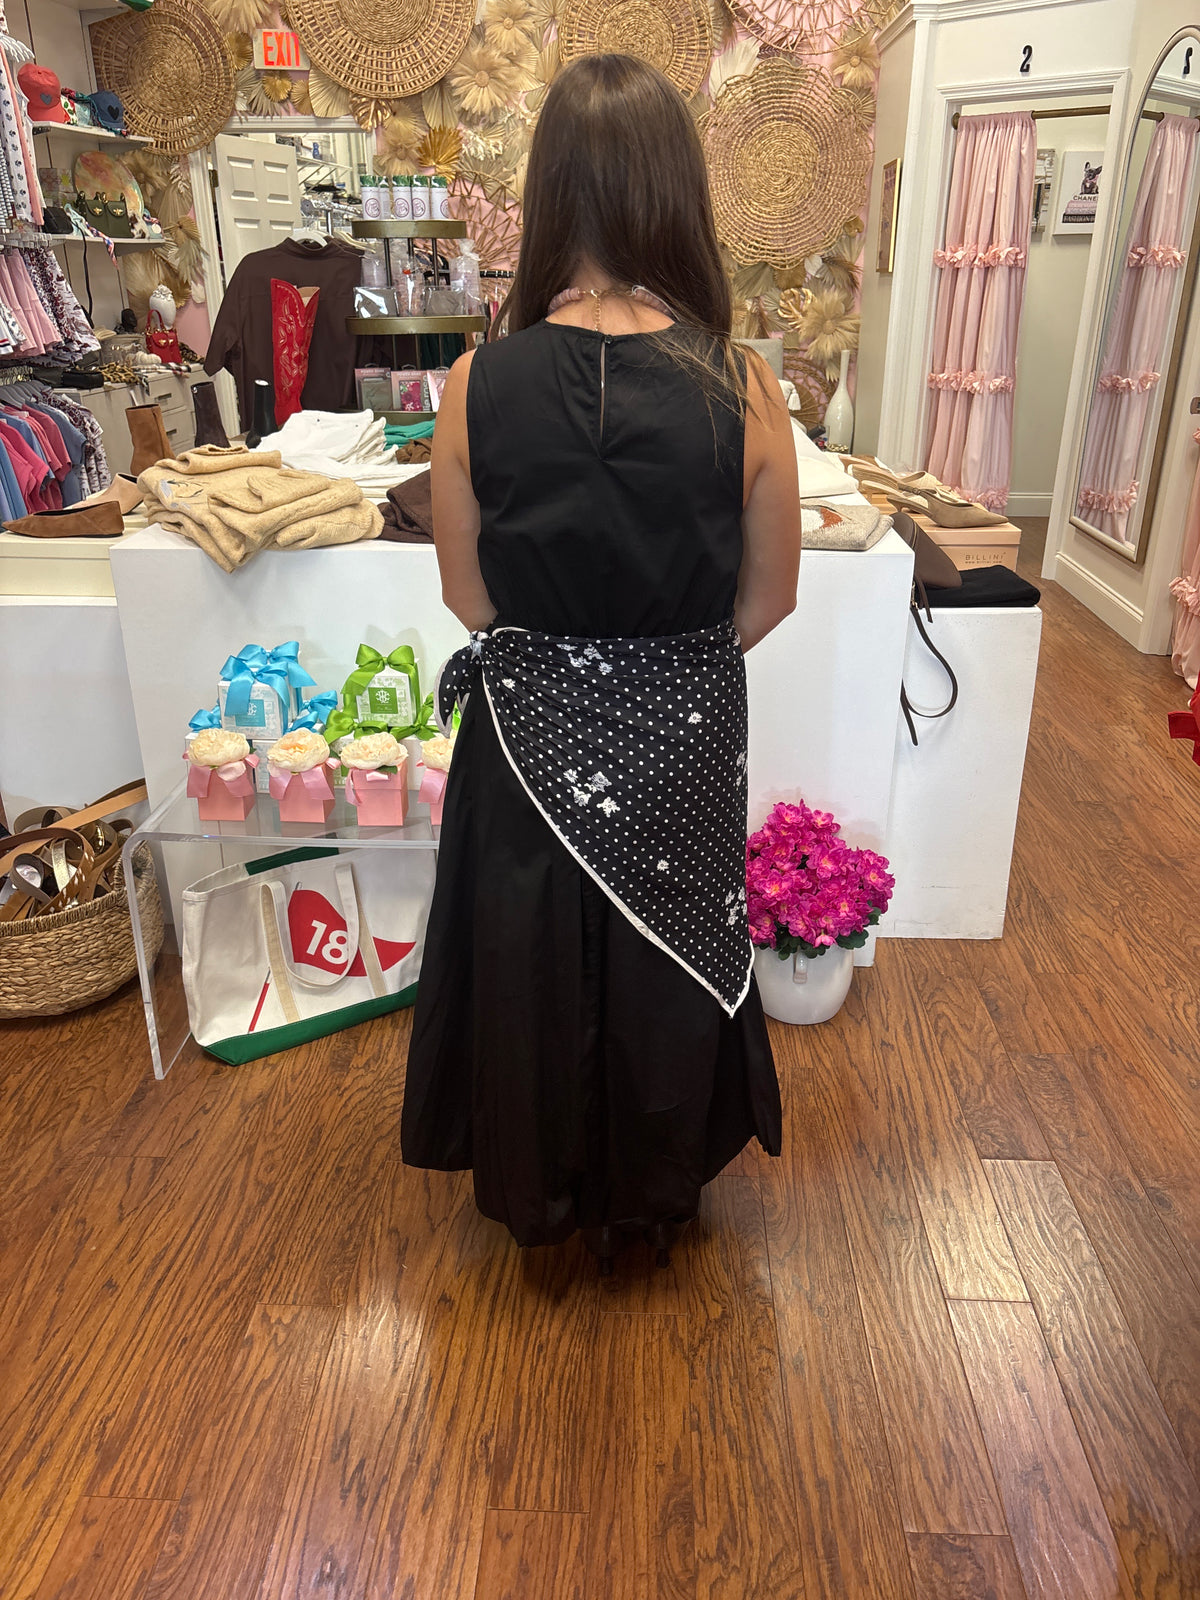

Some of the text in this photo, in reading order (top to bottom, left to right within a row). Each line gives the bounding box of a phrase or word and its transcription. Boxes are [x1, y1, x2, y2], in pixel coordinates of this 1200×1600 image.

[262, 31, 300, 67] EXIT
[1019, 44, 1033, 73] 2
[306, 919, 349, 965] 18
